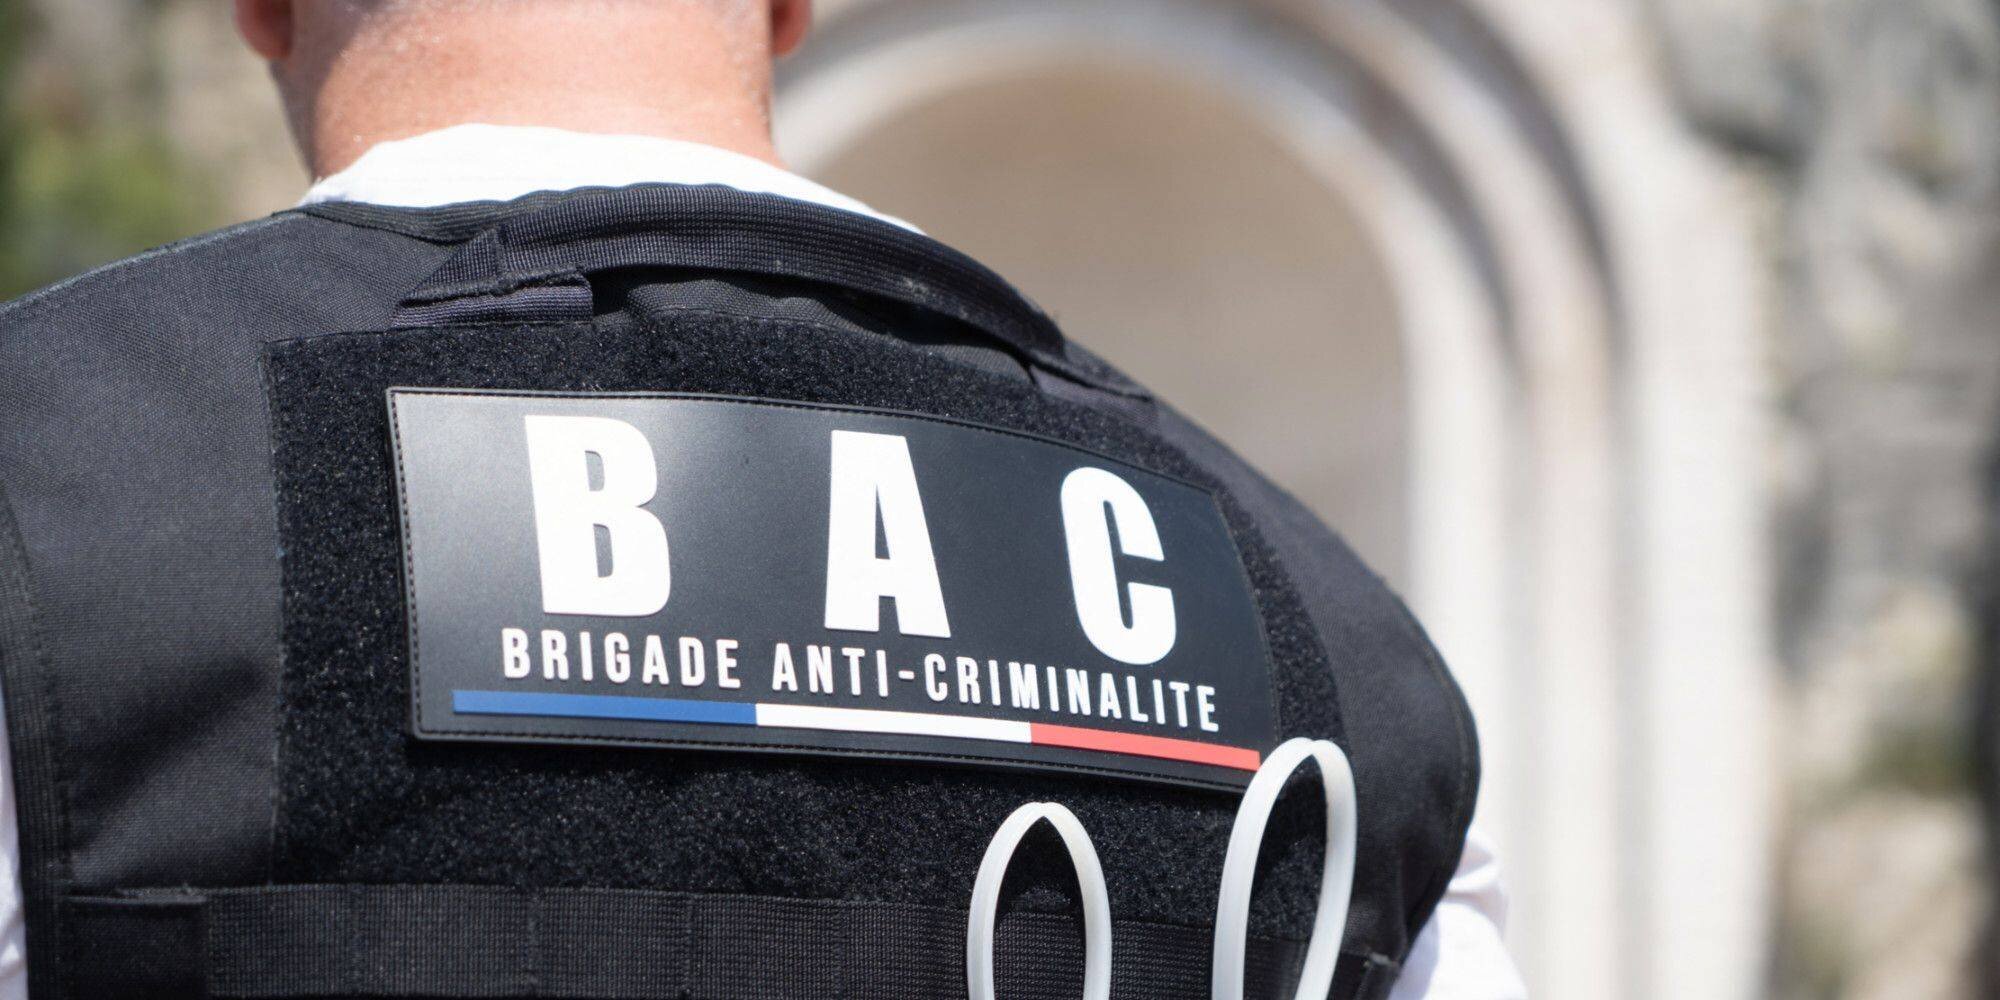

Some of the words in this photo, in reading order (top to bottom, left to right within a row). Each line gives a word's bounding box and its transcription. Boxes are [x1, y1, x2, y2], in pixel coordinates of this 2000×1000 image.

[524, 415, 1177, 665] BAC
[500, 626, 742, 690] BRIGADE
[771, 641, 1221, 733] ANTI-CRIMINALITE
